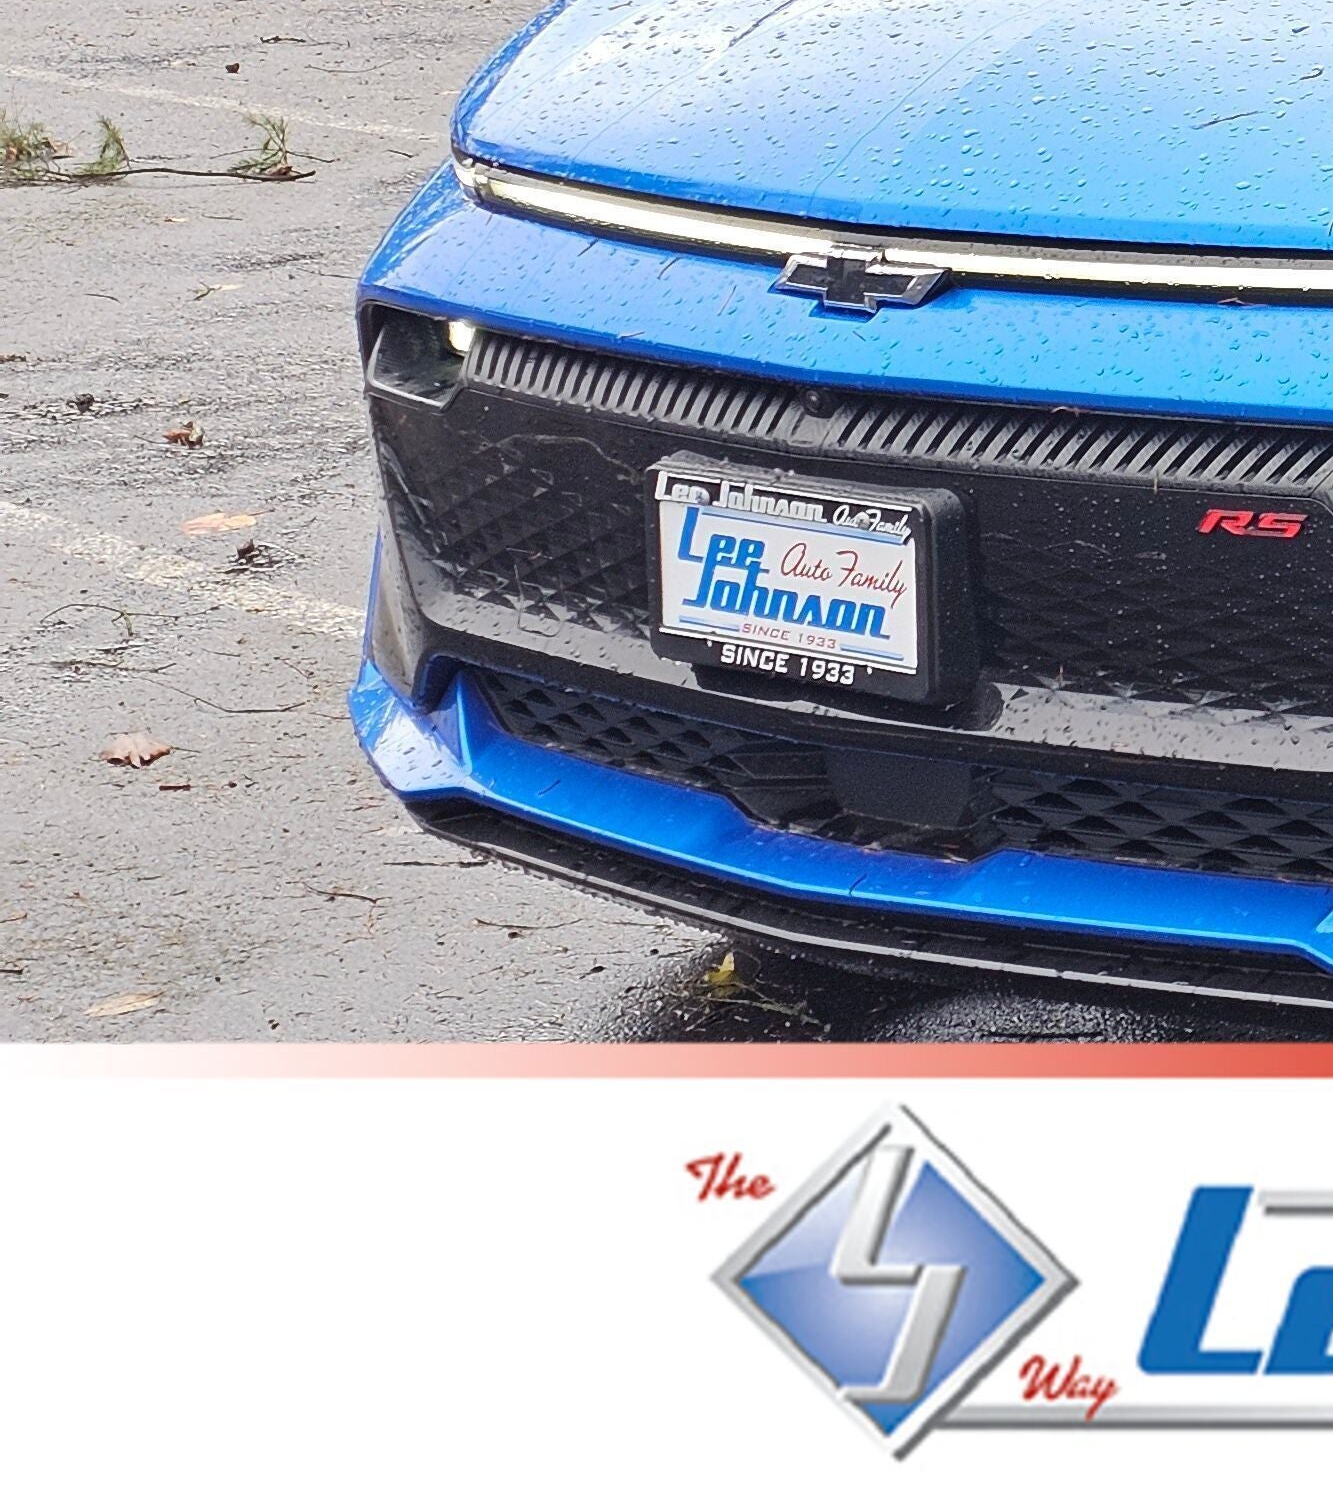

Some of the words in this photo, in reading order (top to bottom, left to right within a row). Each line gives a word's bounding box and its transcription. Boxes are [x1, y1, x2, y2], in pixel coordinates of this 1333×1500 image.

[712, 480, 828, 523] Johnson
[677, 506, 770, 574] Lee
[1198, 508, 1309, 539] RS
[780, 542, 832, 581] Auto
[836, 550, 907, 609] Family
[682, 558, 890, 639] Johnson
[742, 623, 791, 640] SINCE
[798, 632, 836, 649] 1933
[721, 644, 790, 673] SINCE
[800, 657, 855, 685] 1933
